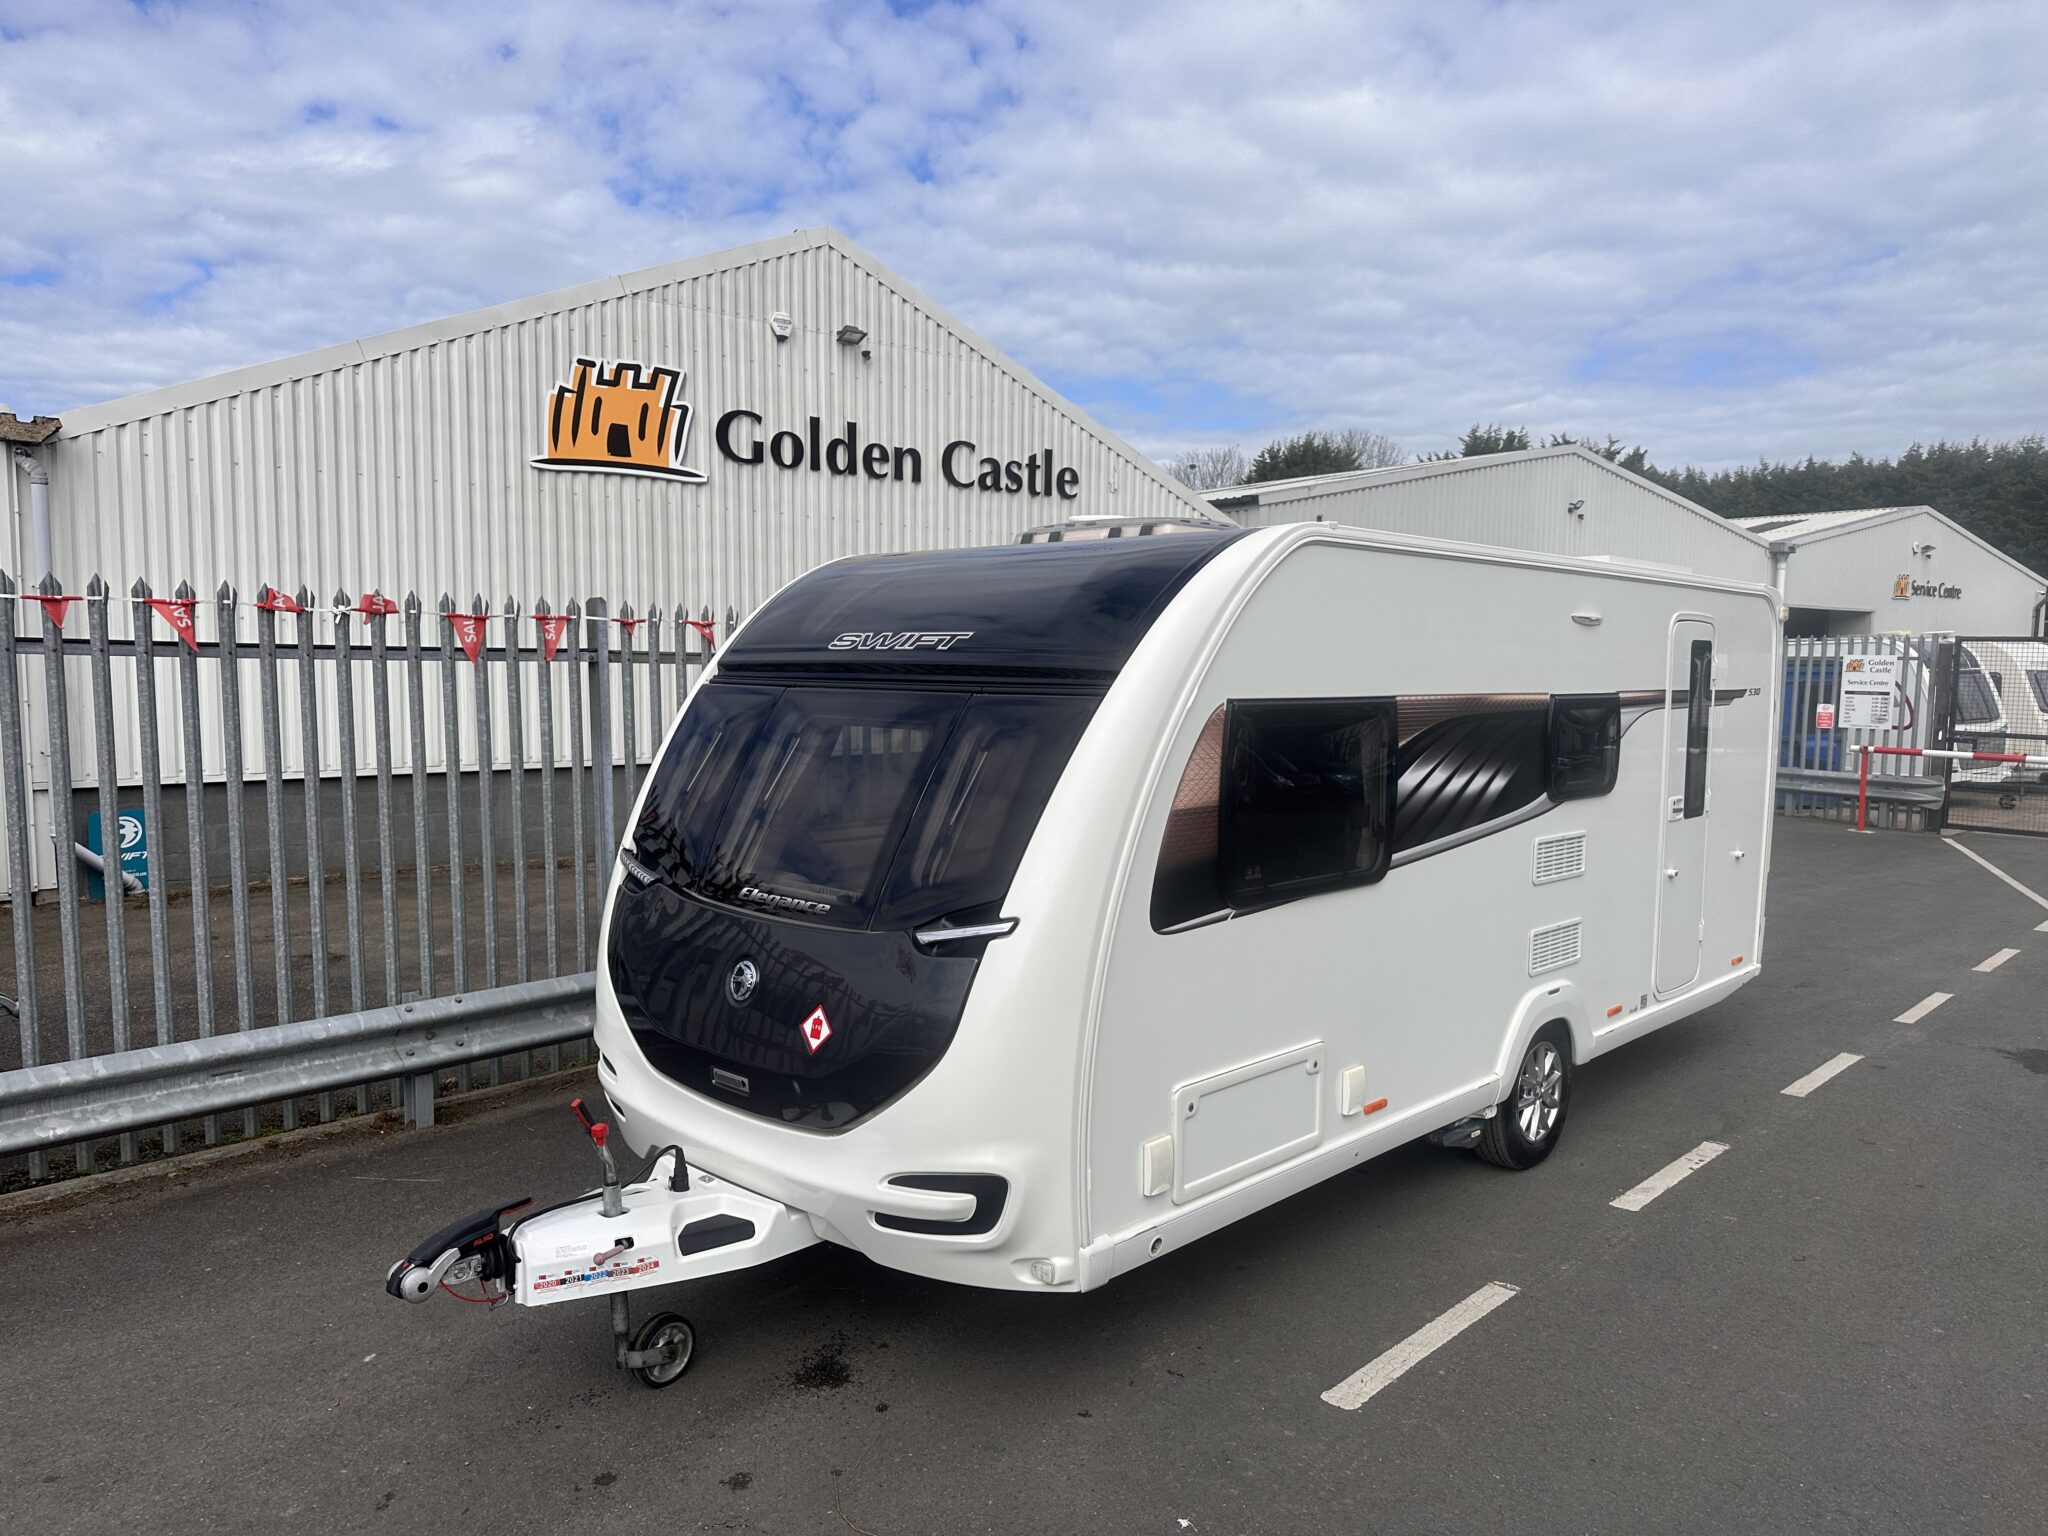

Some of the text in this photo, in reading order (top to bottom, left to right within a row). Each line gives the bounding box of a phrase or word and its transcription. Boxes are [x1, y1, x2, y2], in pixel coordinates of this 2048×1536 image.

[716, 410, 1079, 500] Golden Castle
[1911, 580, 1962, 600] Service Centre
[828, 631, 975, 650] SWIFT
[738, 887, 831, 915] Elegance
[612, 1267, 630, 1277] 2023
[638, 1262, 655, 1272] 2024
[565, 1274, 583, 1284] 2021
[590, 1270, 608, 1280] 2022
[540, 1280, 557, 1288] 2020
